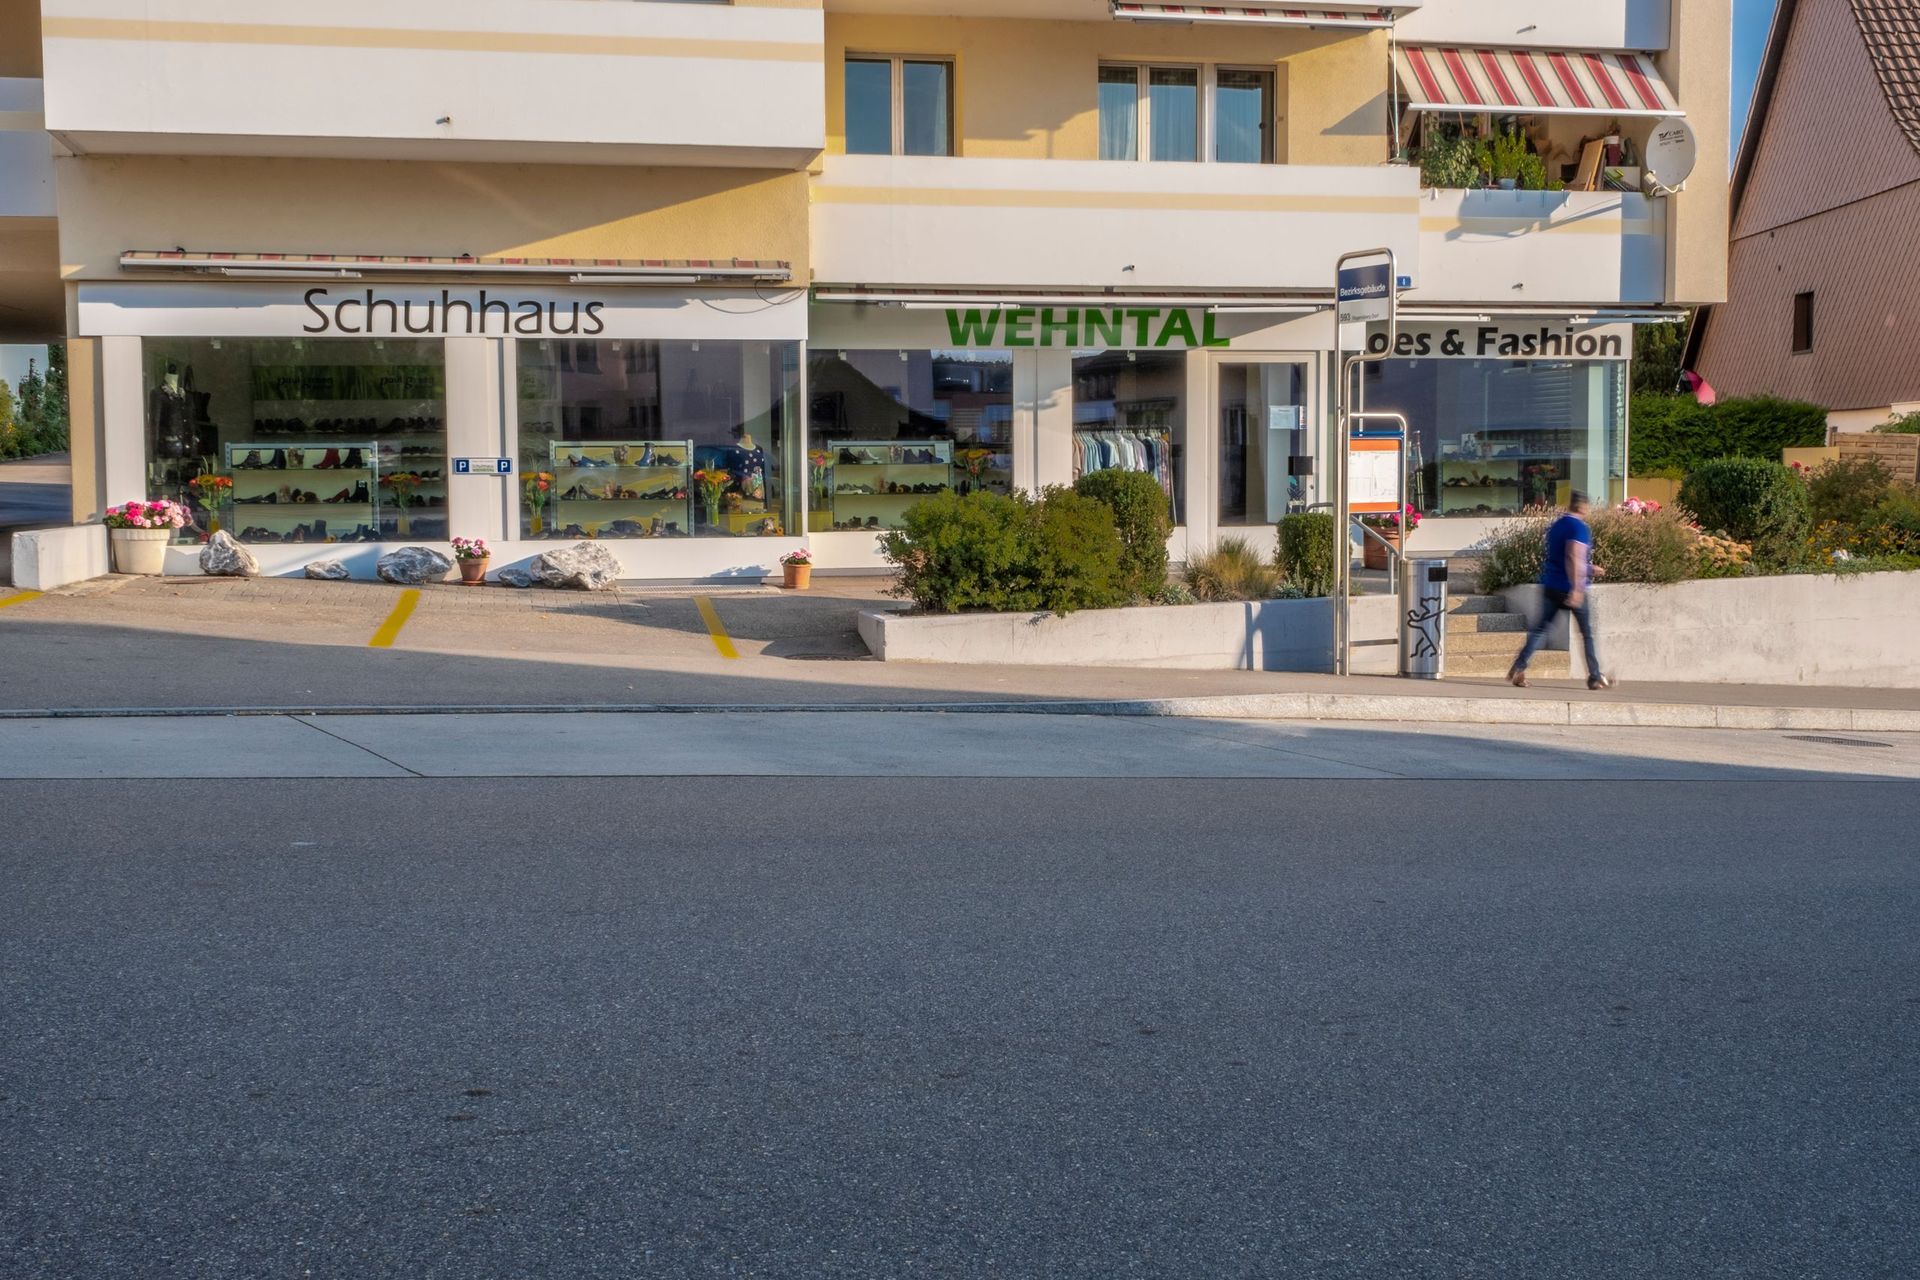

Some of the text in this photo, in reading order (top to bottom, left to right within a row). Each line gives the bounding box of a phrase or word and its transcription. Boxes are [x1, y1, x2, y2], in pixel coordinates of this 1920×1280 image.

[1340, 283, 1386, 297] Bezirksgebäude
[303, 288, 605, 334] Schuhhaus
[1340, 313, 1351, 322] 593
[945, 308, 1230, 346] WEHNTAL
[1440, 328, 1464, 356] &
[1477, 326, 1622, 357] Fashion
[459, 461, 466, 471] P
[501, 461, 508, 471] P
